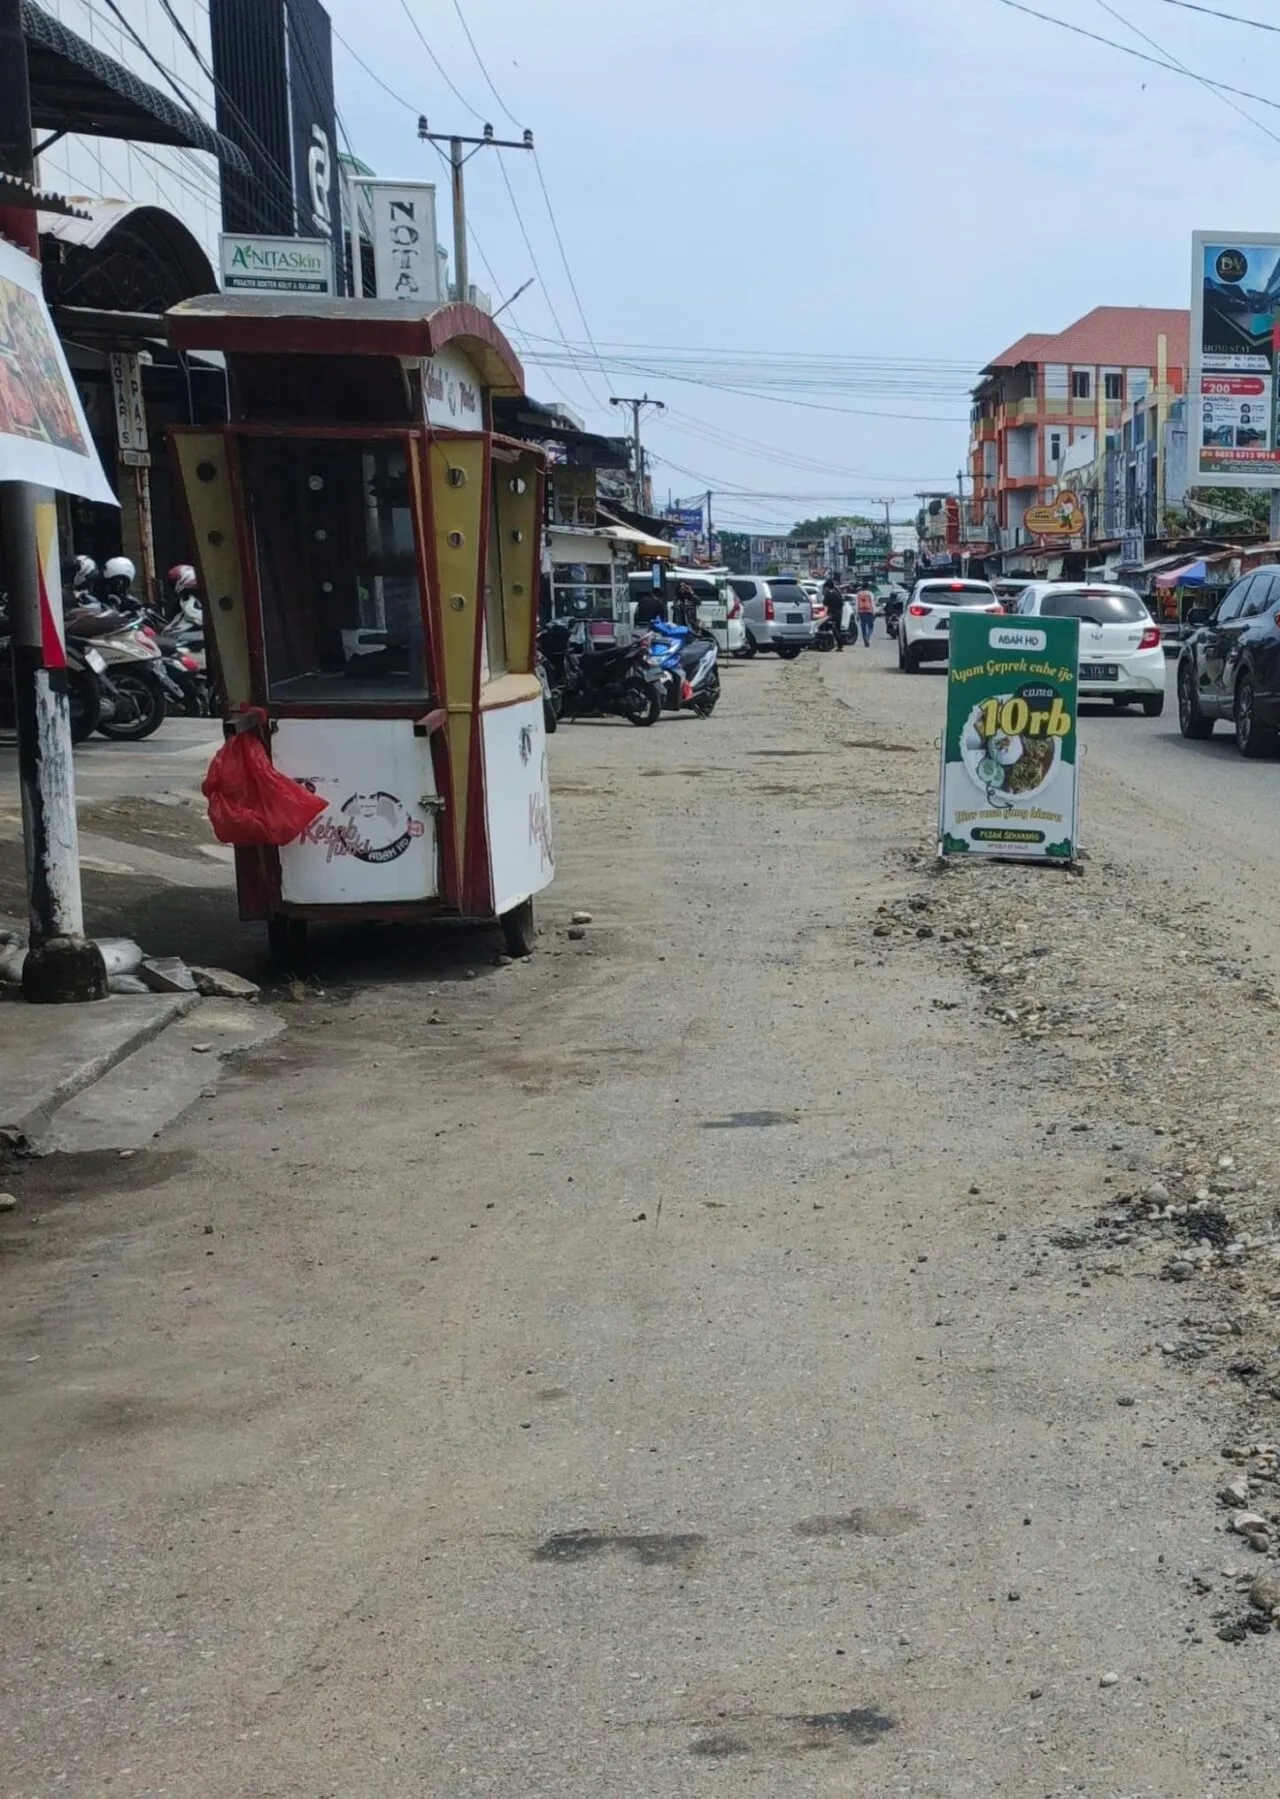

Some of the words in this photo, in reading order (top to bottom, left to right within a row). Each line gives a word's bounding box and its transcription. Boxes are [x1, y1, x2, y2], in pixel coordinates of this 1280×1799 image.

[390, 201, 419, 299] NOTA
[951, 665, 984, 682] Ayam
[986, 658, 1027, 676] Geprek
[1057, 668, 1073, 681] ijo
[979, 698, 1071, 736] 10rb
